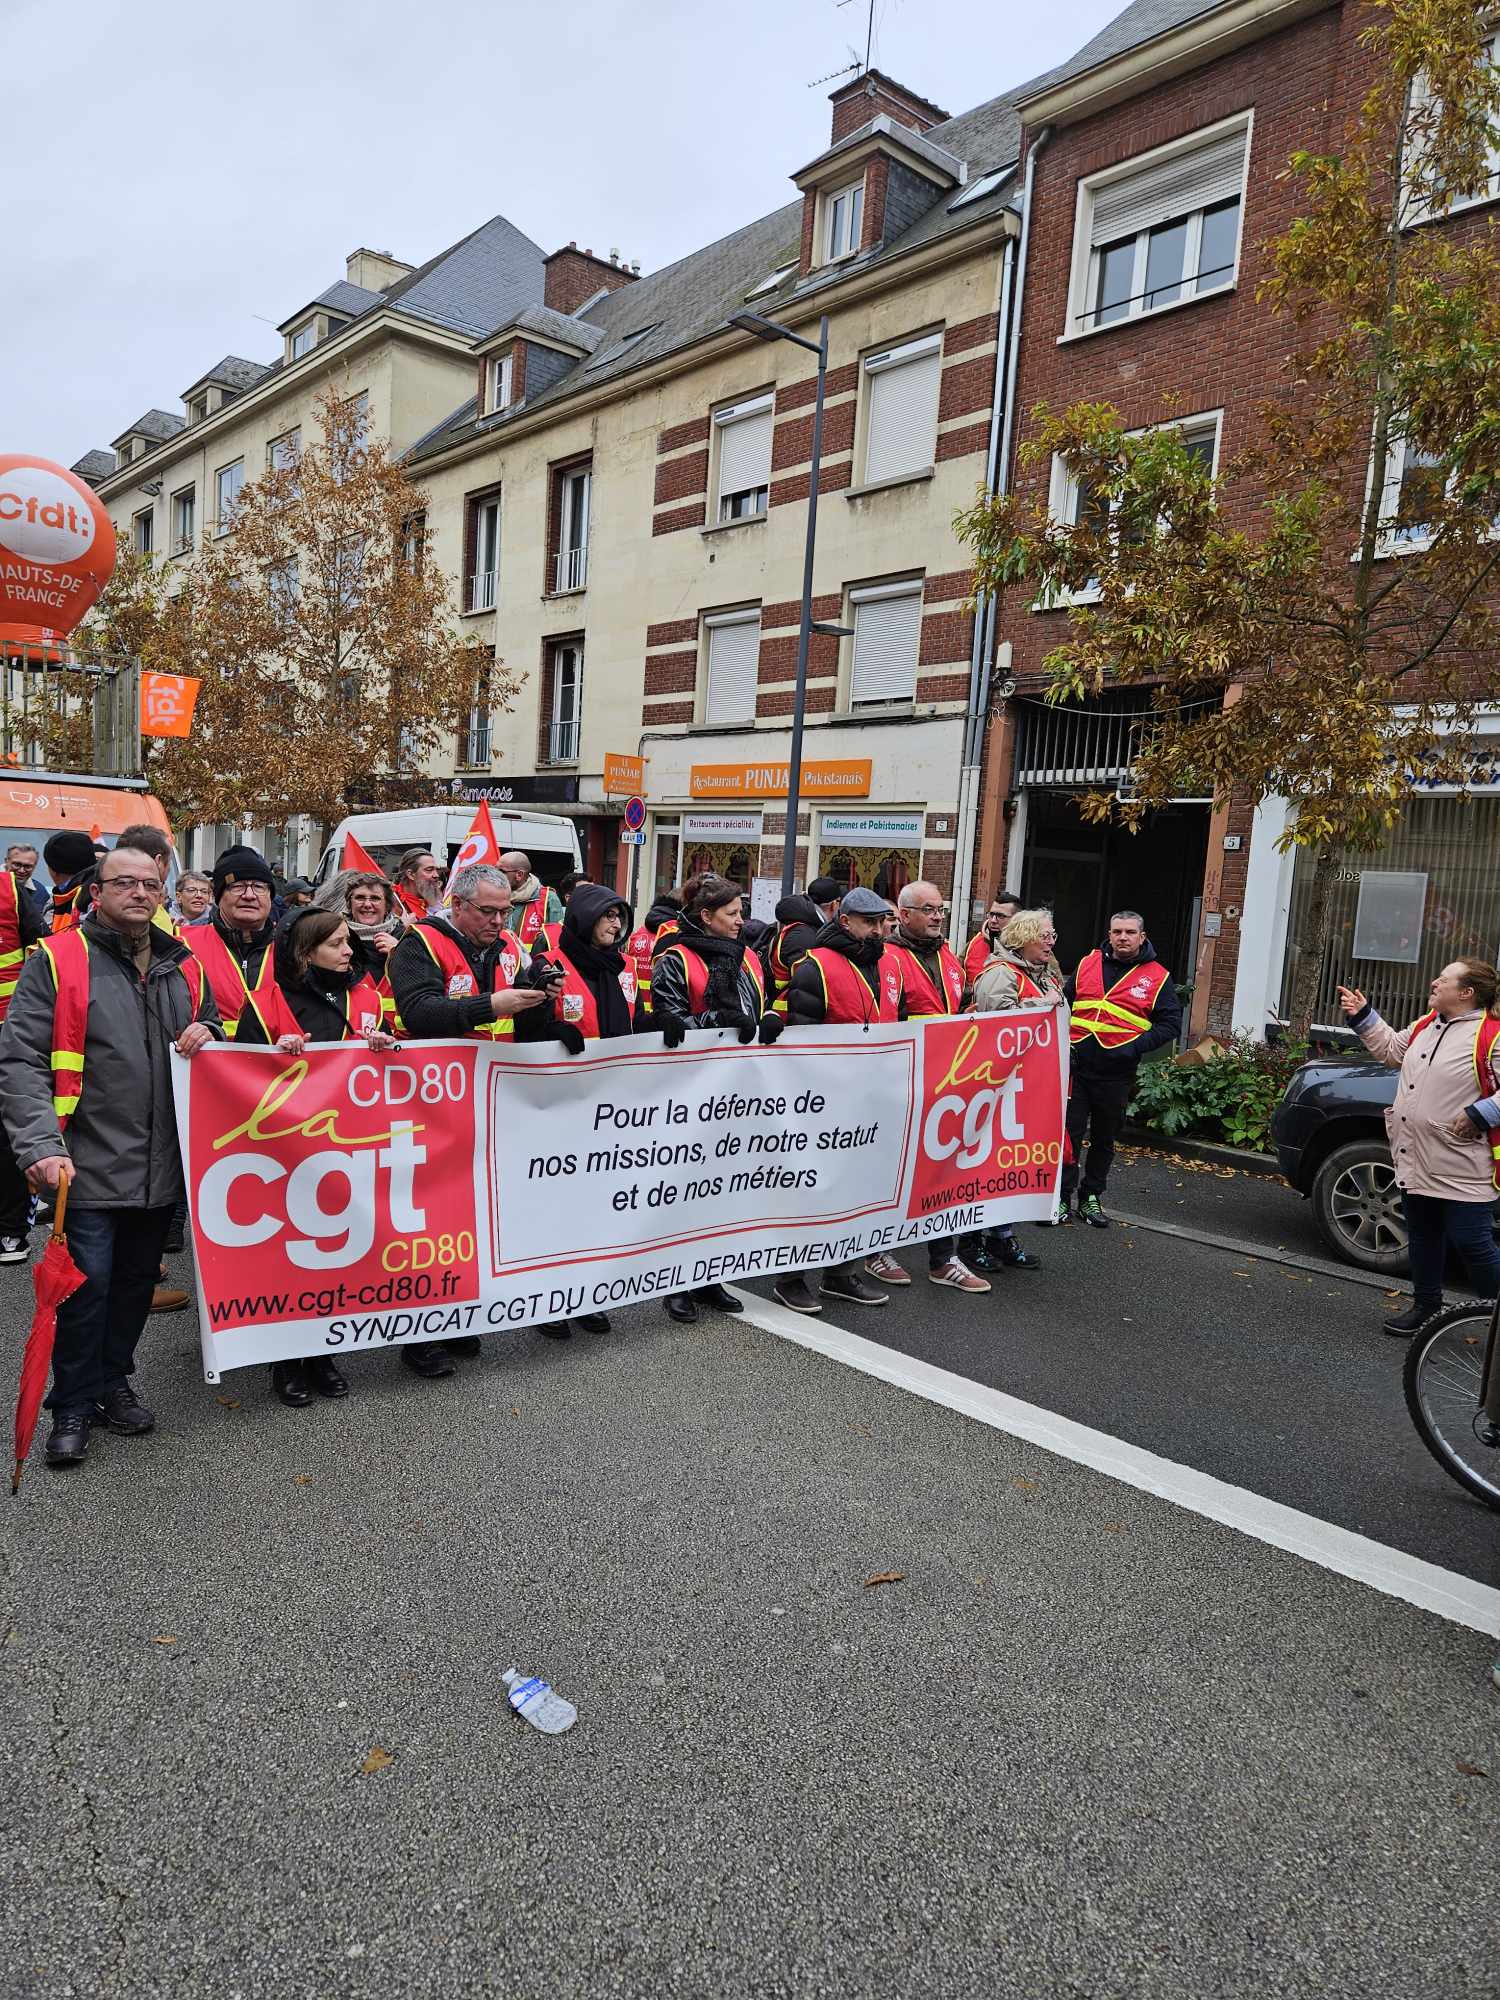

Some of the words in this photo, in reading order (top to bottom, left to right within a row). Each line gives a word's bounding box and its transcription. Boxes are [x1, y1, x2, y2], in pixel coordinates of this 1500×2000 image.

[6, 584, 67, 608] FRANCE
[693, 775, 741, 791] Restaurant
[744, 768, 790, 789] PUNJA
[804, 771, 864, 786] Pakistanais
[689, 819, 721, 829] Restaurant
[723, 820, 755, 830] spécialités
[826, 819, 858, 830] Indiennes
[859, 821, 867, 830] et
[868, 820, 918, 832] Pakistanaises
[1227, 837, 1236, 848] 5
[212, 1059, 425, 1150] la
[347, 1061, 466, 1107] CD80
[593, 1103, 658, 1131] Pour
[665, 1099, 688, 1125] la
[698, 1094, 787, 1121] défense
[793, 1090, 825, 1113] de
[923, 1068, 1024, 1169] cgt
[528, 1154, 578, 1179] nos
[585, 1141, 707, 1173] missions,
[714, 1133, 741, 1158] de
[747, 1128, 808, 1154] notre
[815, 1122, 879, 1150] statut
[997, 1142, 1061, 1168] CD80
[198, 1119, 427, 1270] cgt
[612, 1184, 639, 1211] et
[646, 1181, 678, 1207] de
[683, 1175, 722, 1202] nos
[728, 1166, 818, 1193] métiers
[921, 1168, 1051, 1210] www.cgt-cd80.fr
[381, 1231, 474, 1273] CD80
[326, 1305, 482, 1345] SYNDICAT
[487, 1293, 543, 1325] CGT
[549, 1286, 585, 1315] DU
[592, 1265, 686, 1305] CONSEIL
[692, 1237, 864, 1281] DEPARTEMENTAL
[868, 1230, 896, 1252] DE
[897, 1219, 918, 1241] LA
[922, 1206, 984, 1236] SOMME
[210, 1271, 461, 1323] www.cgt-cd80.fr
